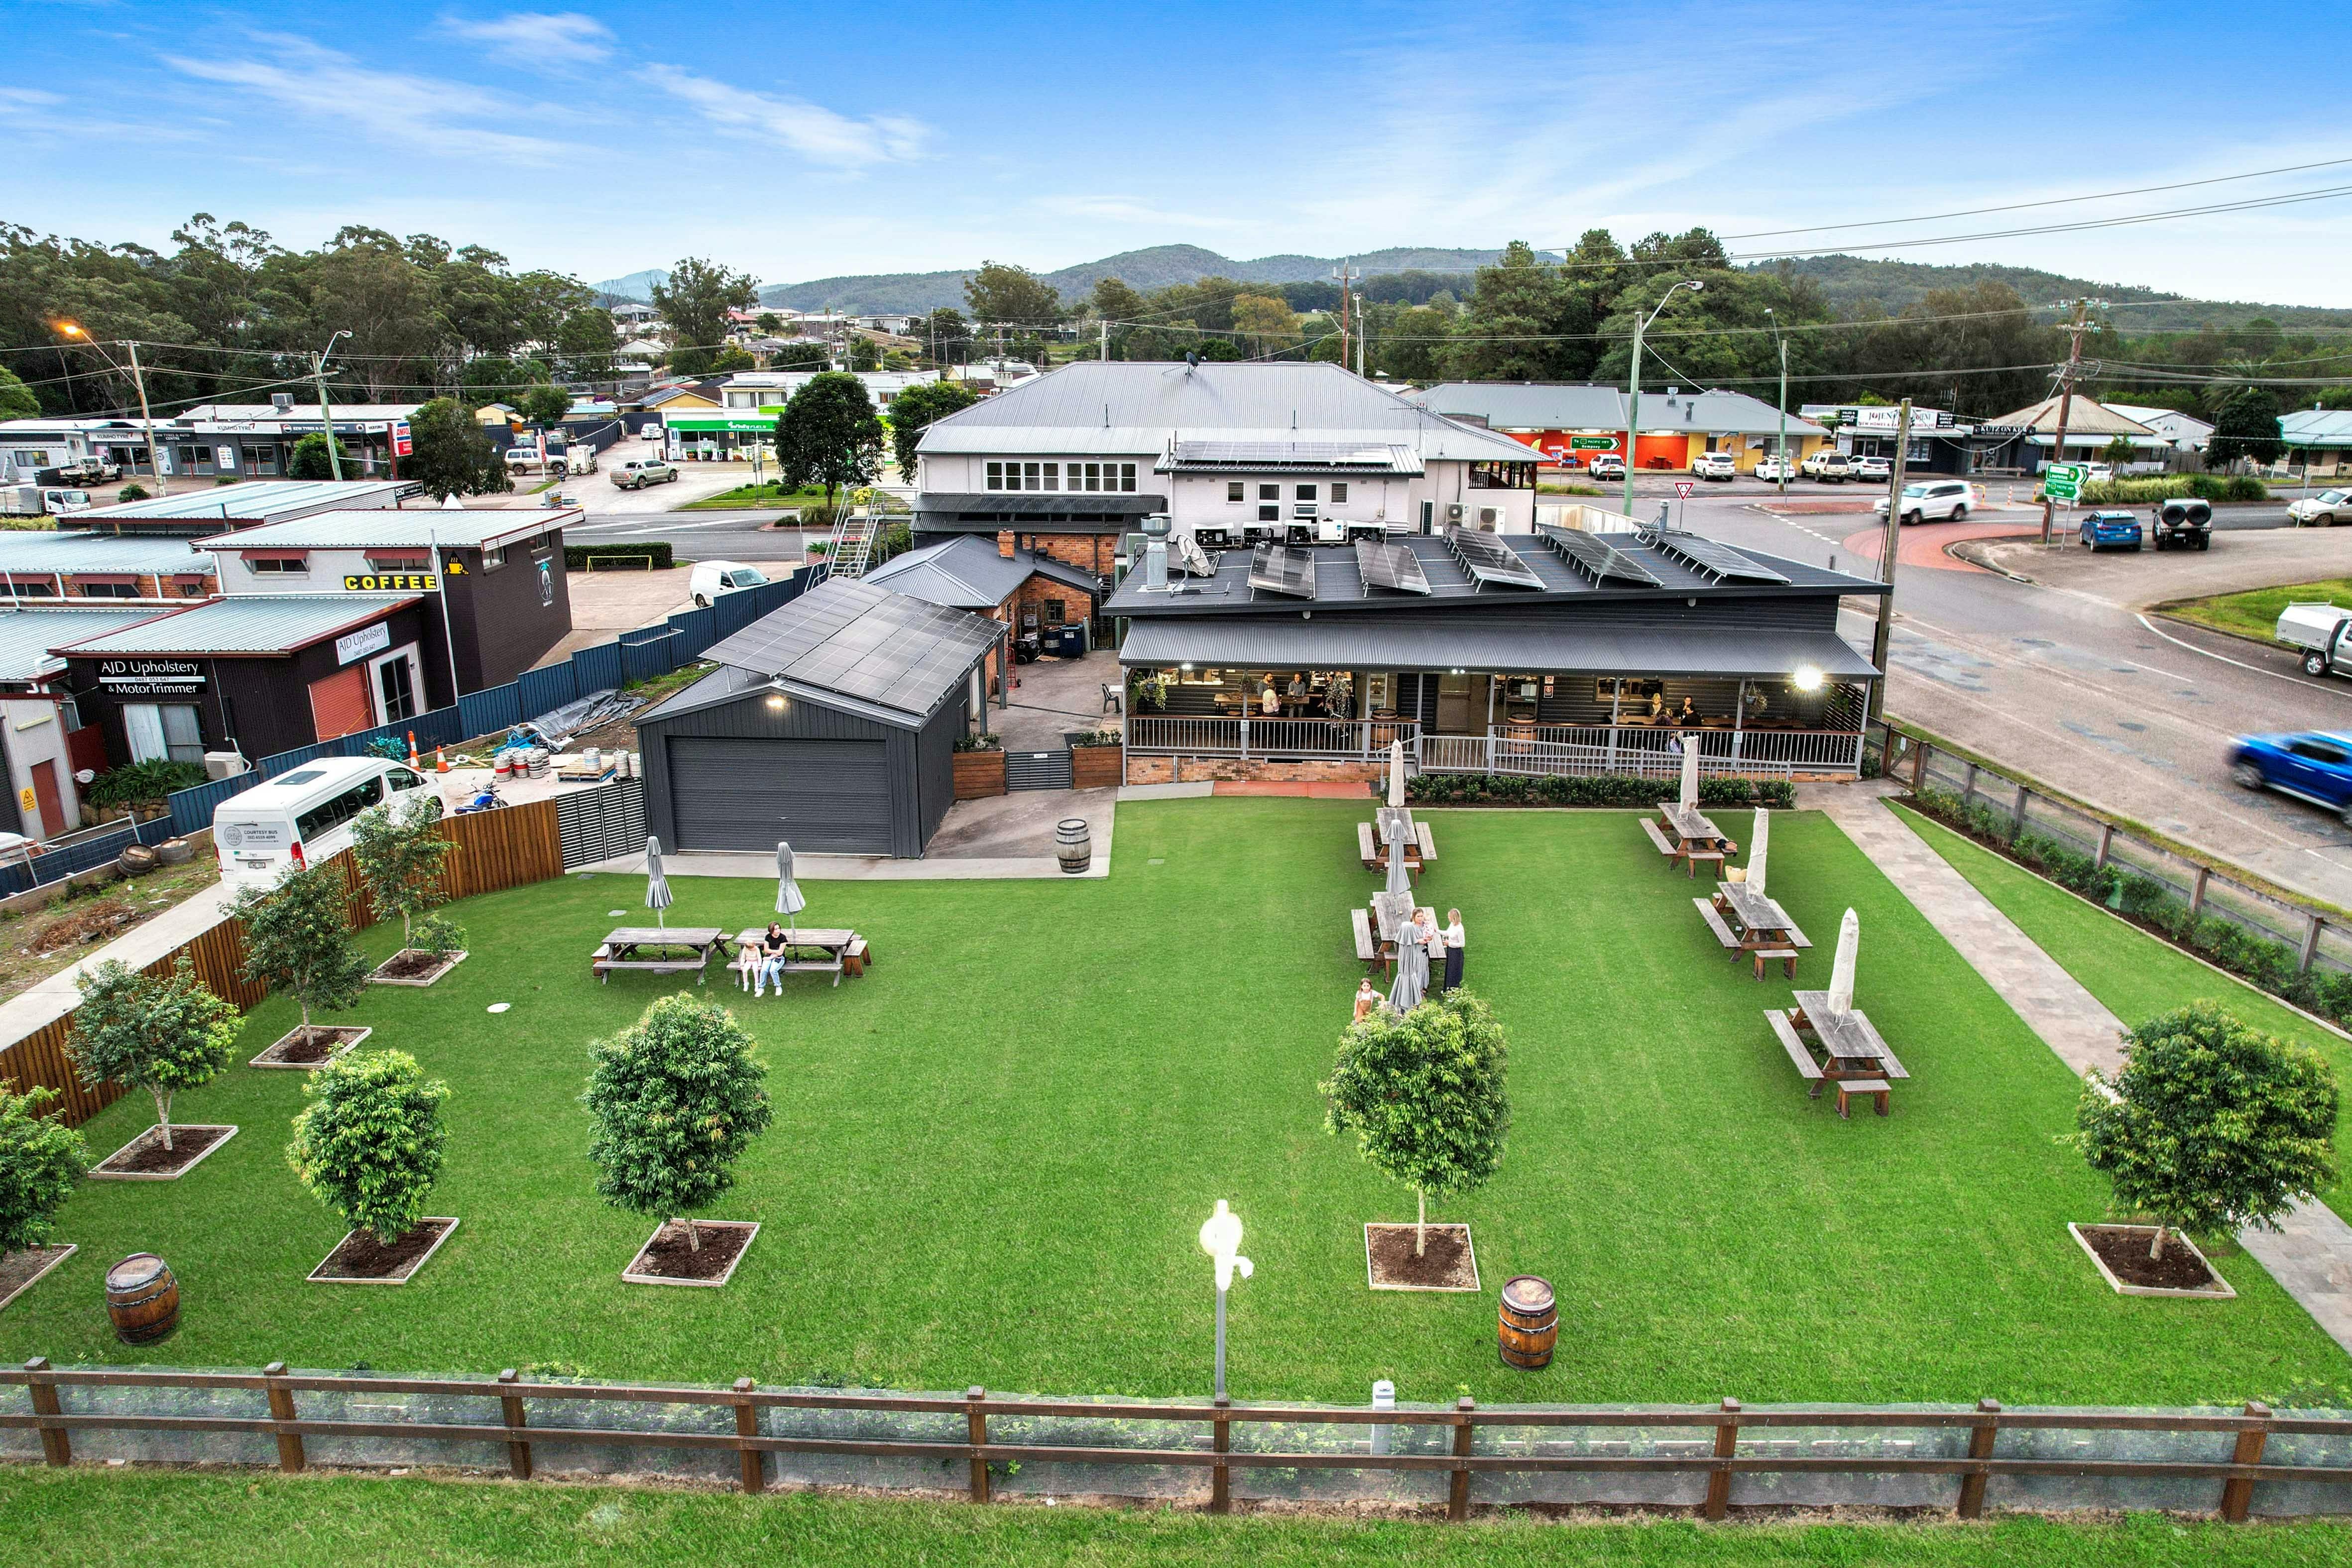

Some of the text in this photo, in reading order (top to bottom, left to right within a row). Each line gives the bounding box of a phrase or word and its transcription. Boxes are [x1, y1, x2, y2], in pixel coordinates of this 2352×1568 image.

[397, 427, 410, 436] AMPOL
[345, 576, 437, 590] COFFEE
[339, 627, 386, 652] AJD Upholstery
[102, 660, 198, 676] AJD Upholstery
[116, 683, 197, 694] MotorTrimmer
